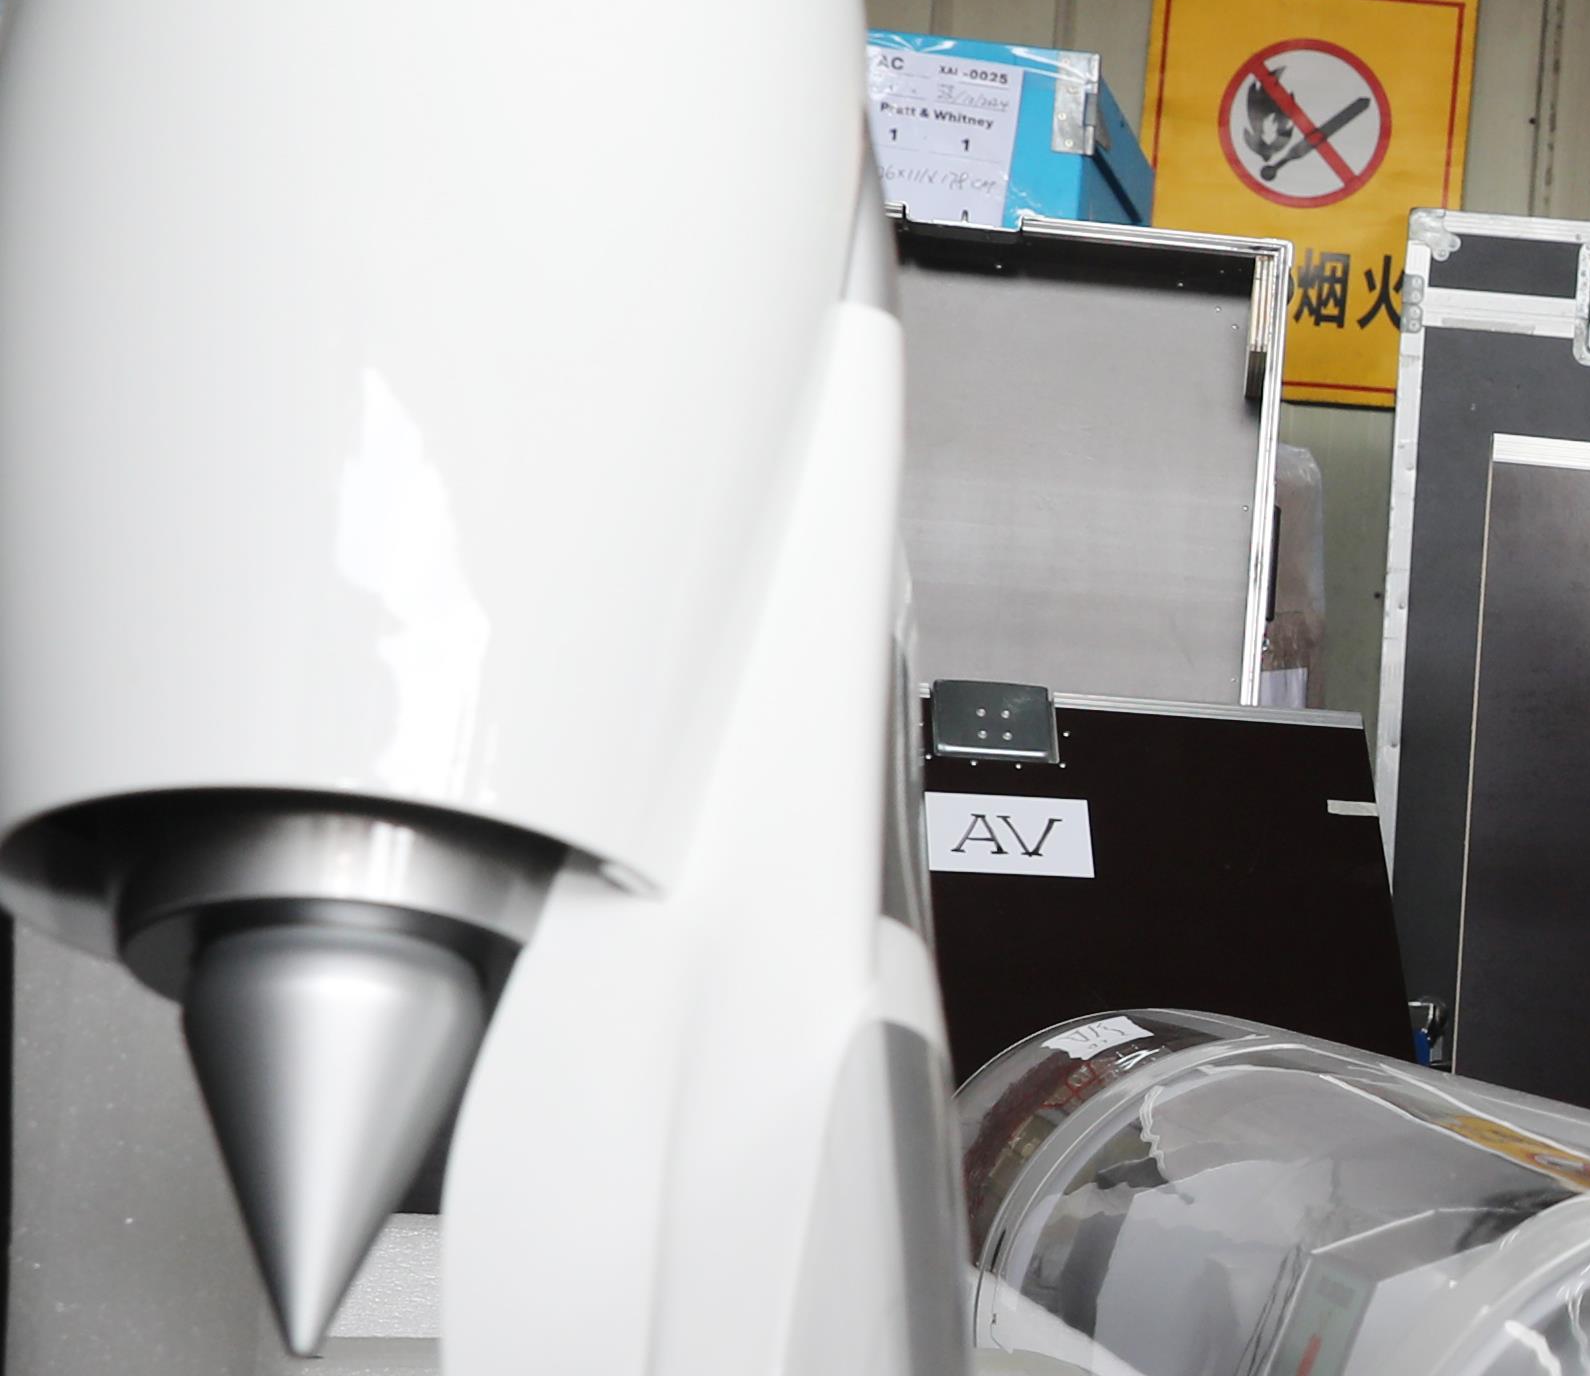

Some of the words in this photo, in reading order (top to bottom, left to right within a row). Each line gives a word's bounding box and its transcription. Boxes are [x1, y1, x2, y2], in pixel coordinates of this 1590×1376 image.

[920, 108, 930, 120] &
[934, 109, 994, 130] Whitney
[889, 128, 898, 141] 1
[962, 138, 970, 152] 1
[1287, 248, 1403, 330] 烟火
[951, 813, 1063, 857] AV
